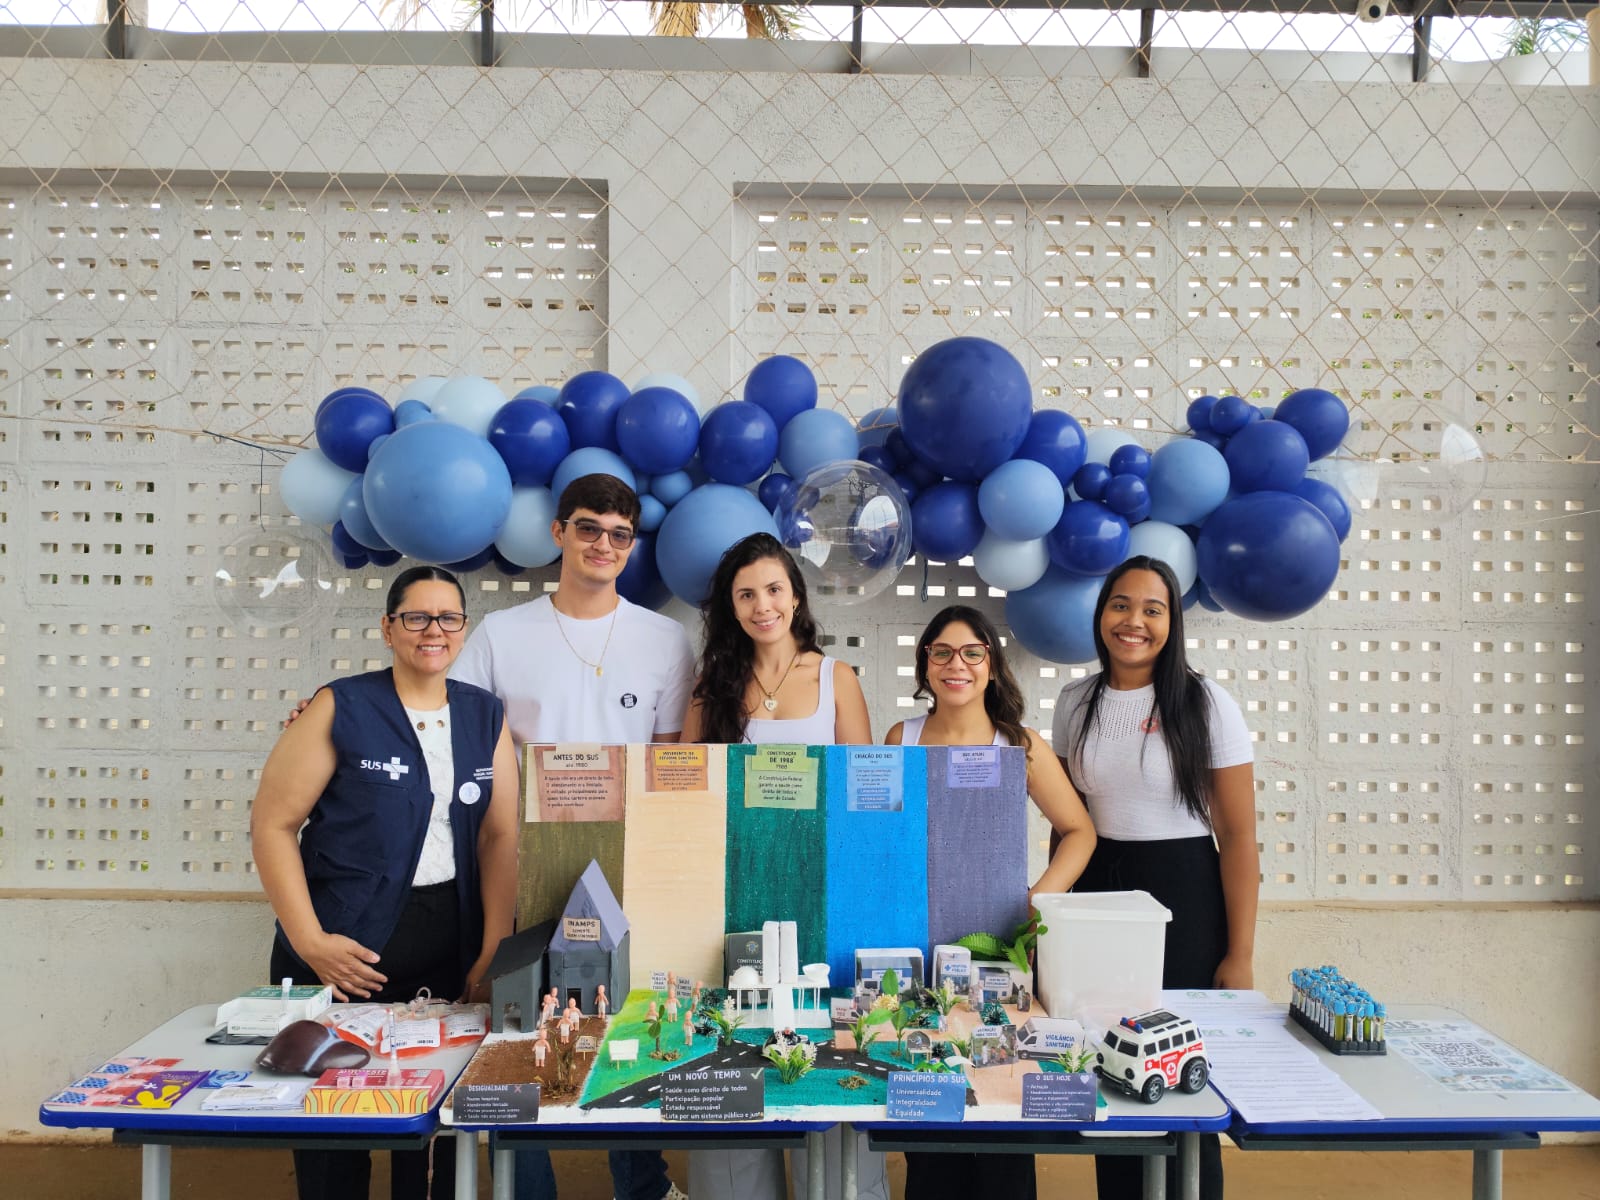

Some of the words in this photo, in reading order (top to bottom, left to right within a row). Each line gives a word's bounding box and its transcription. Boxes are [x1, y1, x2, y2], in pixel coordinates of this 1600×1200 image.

[360, 759, 381, 770] SUS
[1046, 1034, 1075, 1042] VIGILÂNCIA
[669, 1073, 681, 1081] UM
[686, 1072, 708, 1080] NOVO
[714, 1070, 741, 1080] TEMPO
[938, 1075, 948, 1083] DO
[952, 1075, 966, 1084] SUS
[896, 1088, 942, 1096] Universalidade
[896, 1098, 937, 1107] Integralidade
[686, 1104, 721, 1112] responsável
[724, 1112, 744, 1120] público
[896, 1109, 924, 1118] Equidade
